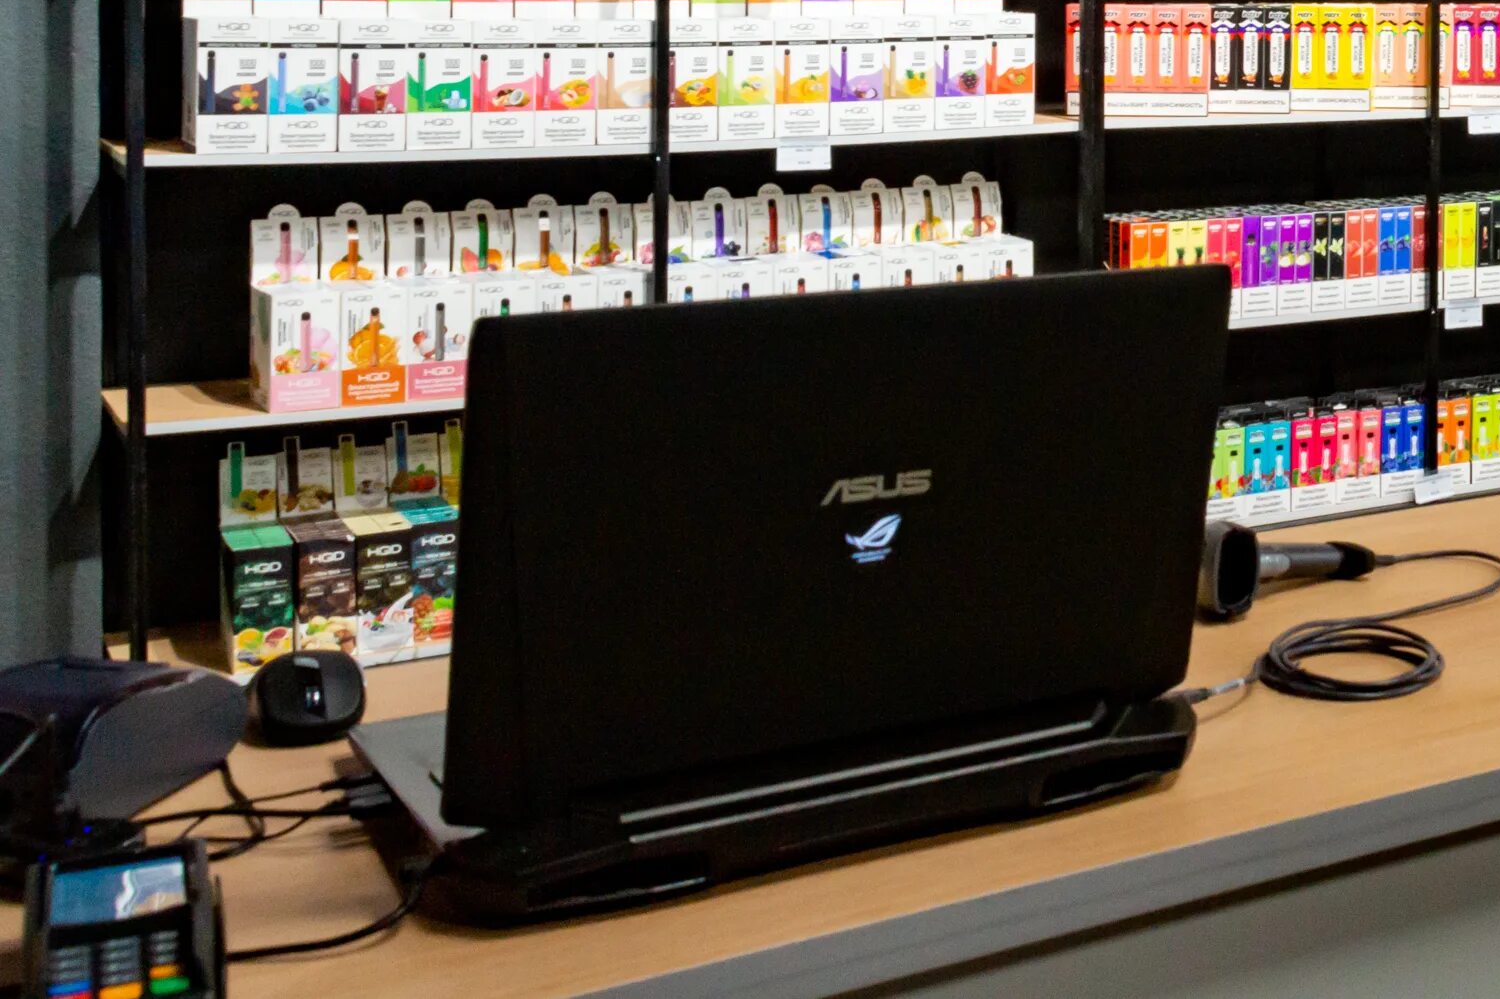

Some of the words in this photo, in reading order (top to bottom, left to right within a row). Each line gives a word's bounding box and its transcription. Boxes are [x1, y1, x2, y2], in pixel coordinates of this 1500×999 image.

[357, 371, 391, 382] HQD
[821, 469, 932, 506] ASUS
[421, 533, 456, 547] HQD
[309, 551, 345, 564] HQD
[367, 543, 403, 558] HQD
[244, 561, 282, 575] HQD
